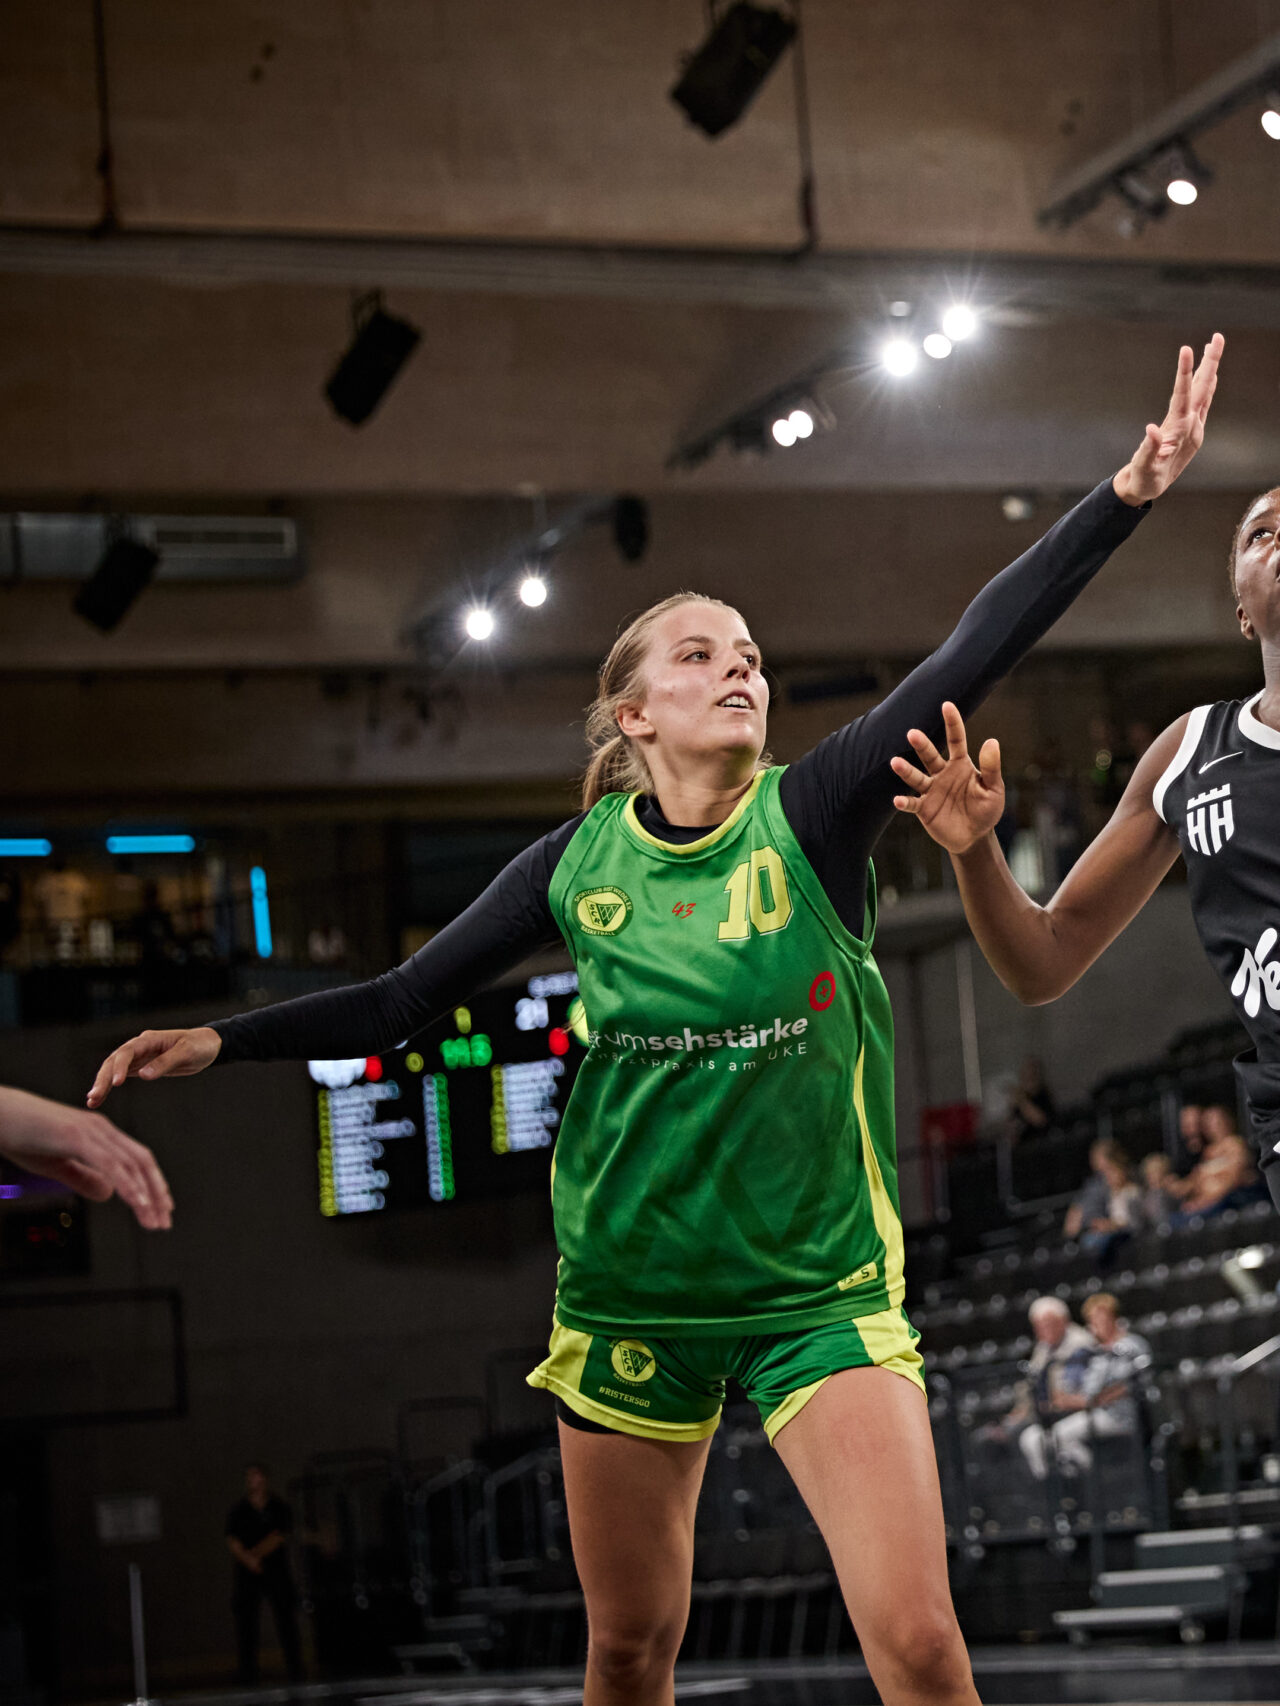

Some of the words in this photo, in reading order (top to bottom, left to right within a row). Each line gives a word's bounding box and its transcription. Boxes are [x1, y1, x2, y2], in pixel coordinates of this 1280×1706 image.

[717, 845, 794, 942] 10
[671, 901, 697, 919] 43
[728, 1060, 757, 1072] am
[768, 1042, 807, 1060] UKE
[599, 1385, 651, 1409] #RISTERSGO
